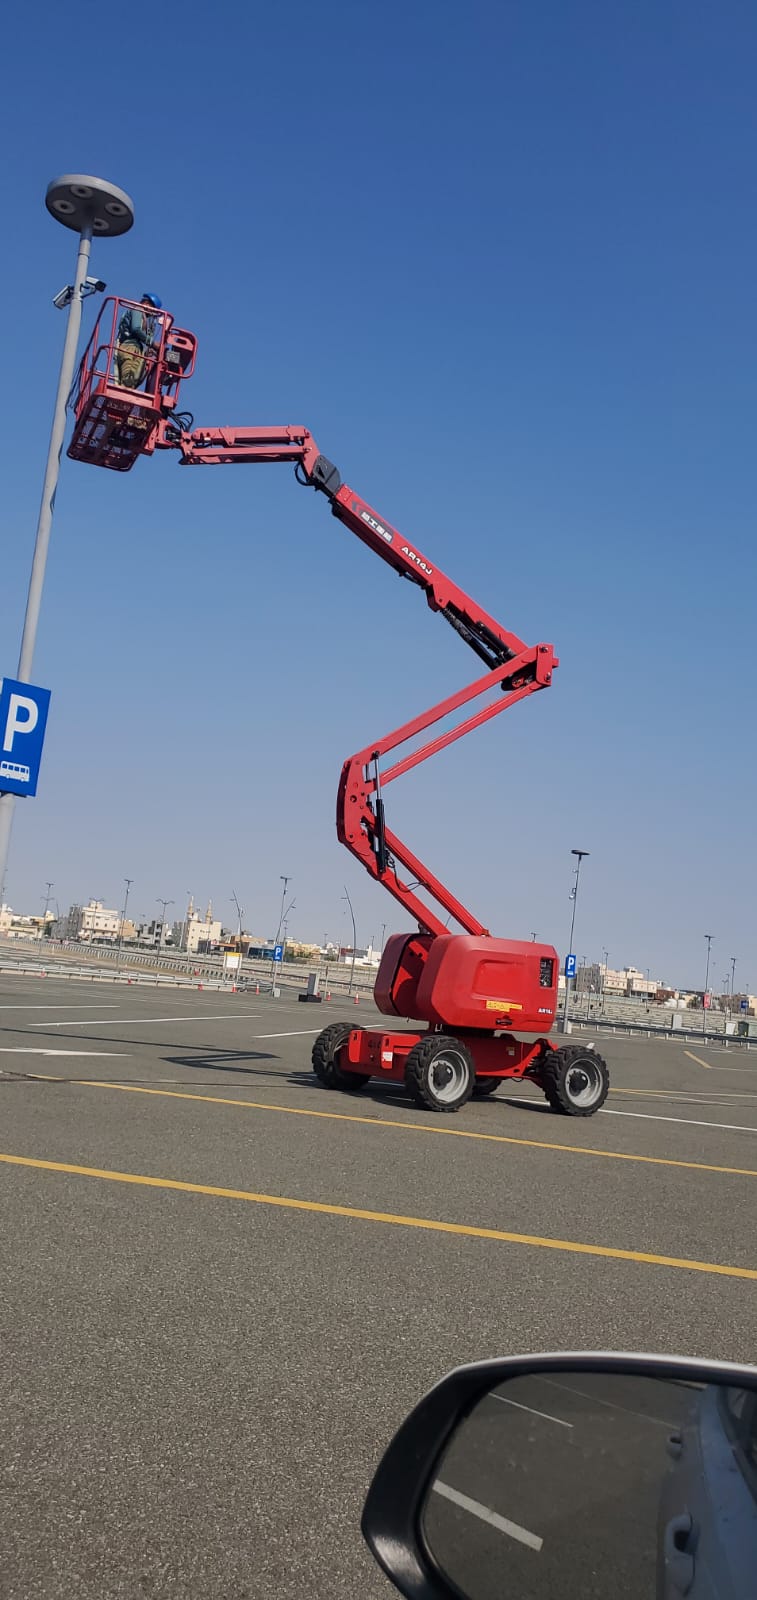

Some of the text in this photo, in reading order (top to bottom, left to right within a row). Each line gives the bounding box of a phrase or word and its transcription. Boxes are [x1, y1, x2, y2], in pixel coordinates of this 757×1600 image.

[401, 546, 433, 575] AR14J
[3, 693, 38, 752] P
[275, 947, 282, 956] P
[567, 956, 574, 969] P
